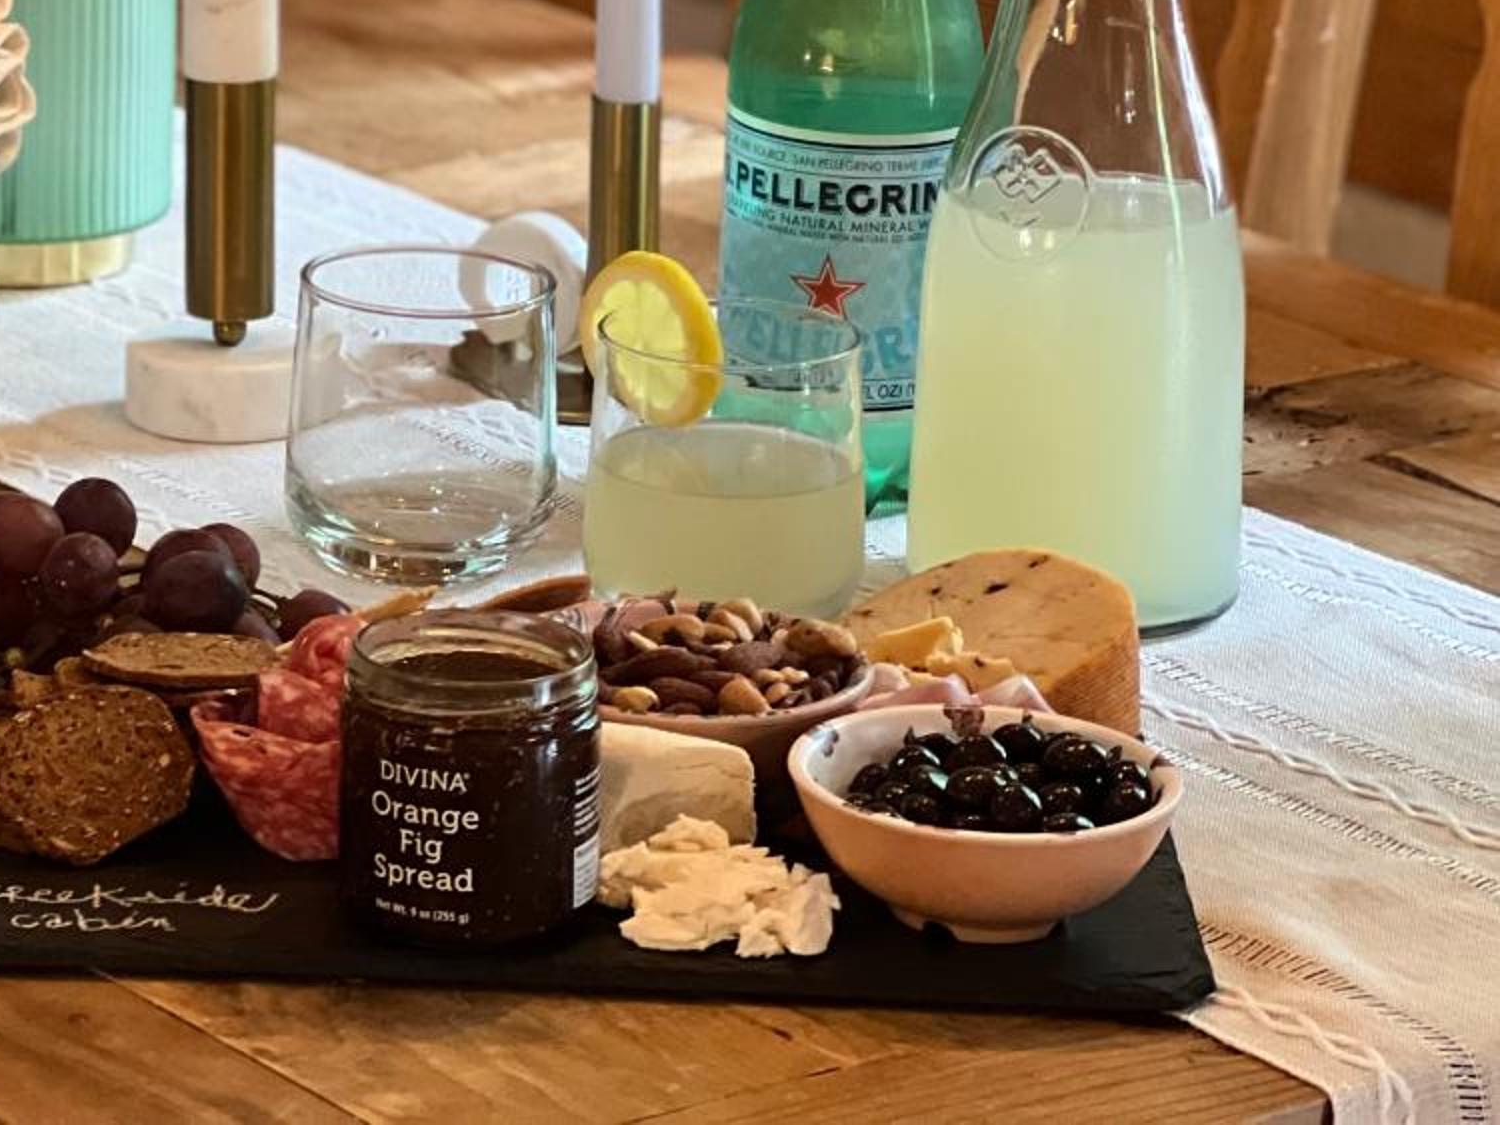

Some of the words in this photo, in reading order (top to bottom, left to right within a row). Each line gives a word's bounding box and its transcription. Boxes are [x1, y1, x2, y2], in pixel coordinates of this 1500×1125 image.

[779, 212, 845, 233] NATURAL
[849, 219, 915, 234] MINERAL
[380, 759, 468, 794] DIVINA
[371, 790, 480, 835] Orange
[400, 827, 444, 864] Fig
[373, 852, 474, 892] Spread
